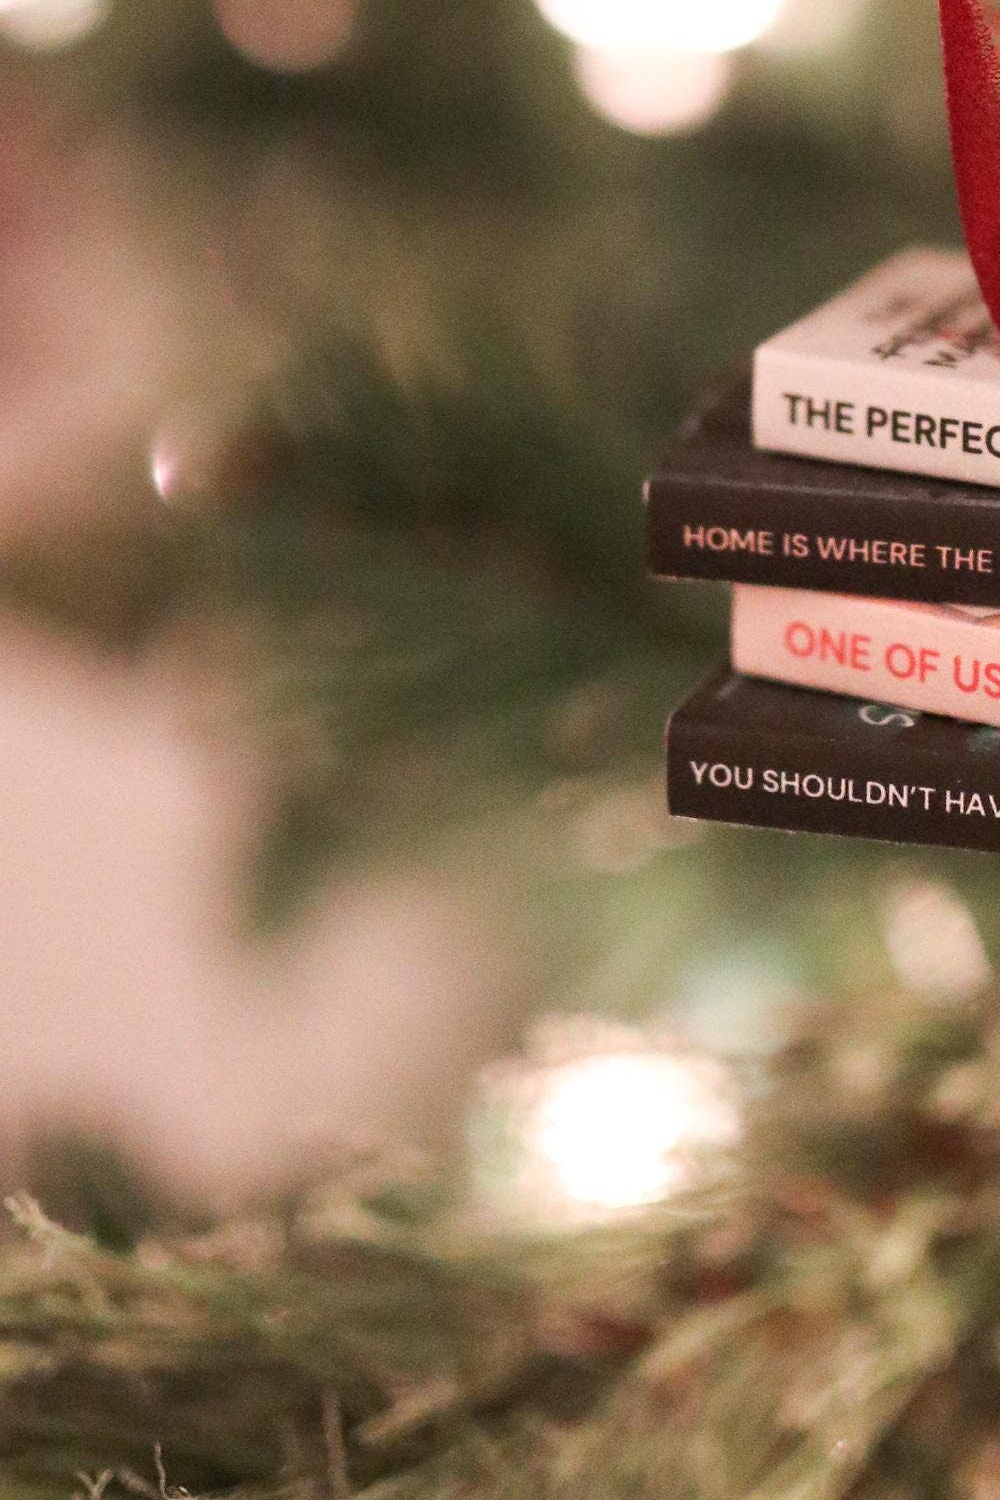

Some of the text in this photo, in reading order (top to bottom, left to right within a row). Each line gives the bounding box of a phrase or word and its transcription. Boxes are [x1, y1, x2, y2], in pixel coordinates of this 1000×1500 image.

[782, 392, 855, 435] THE
[684, 525, 773, 555] HOME
[783, 534, 809, 558] IS
[816, 536, 926, 568] WHERE
[936, 545, 993, 573] THE
[783, 621, 870, 671] ONE
[884, 641, 941, 683] OF
[689, 760, 754, 790] YOU
[762, 769, 937, 811] SHOULDN’T
